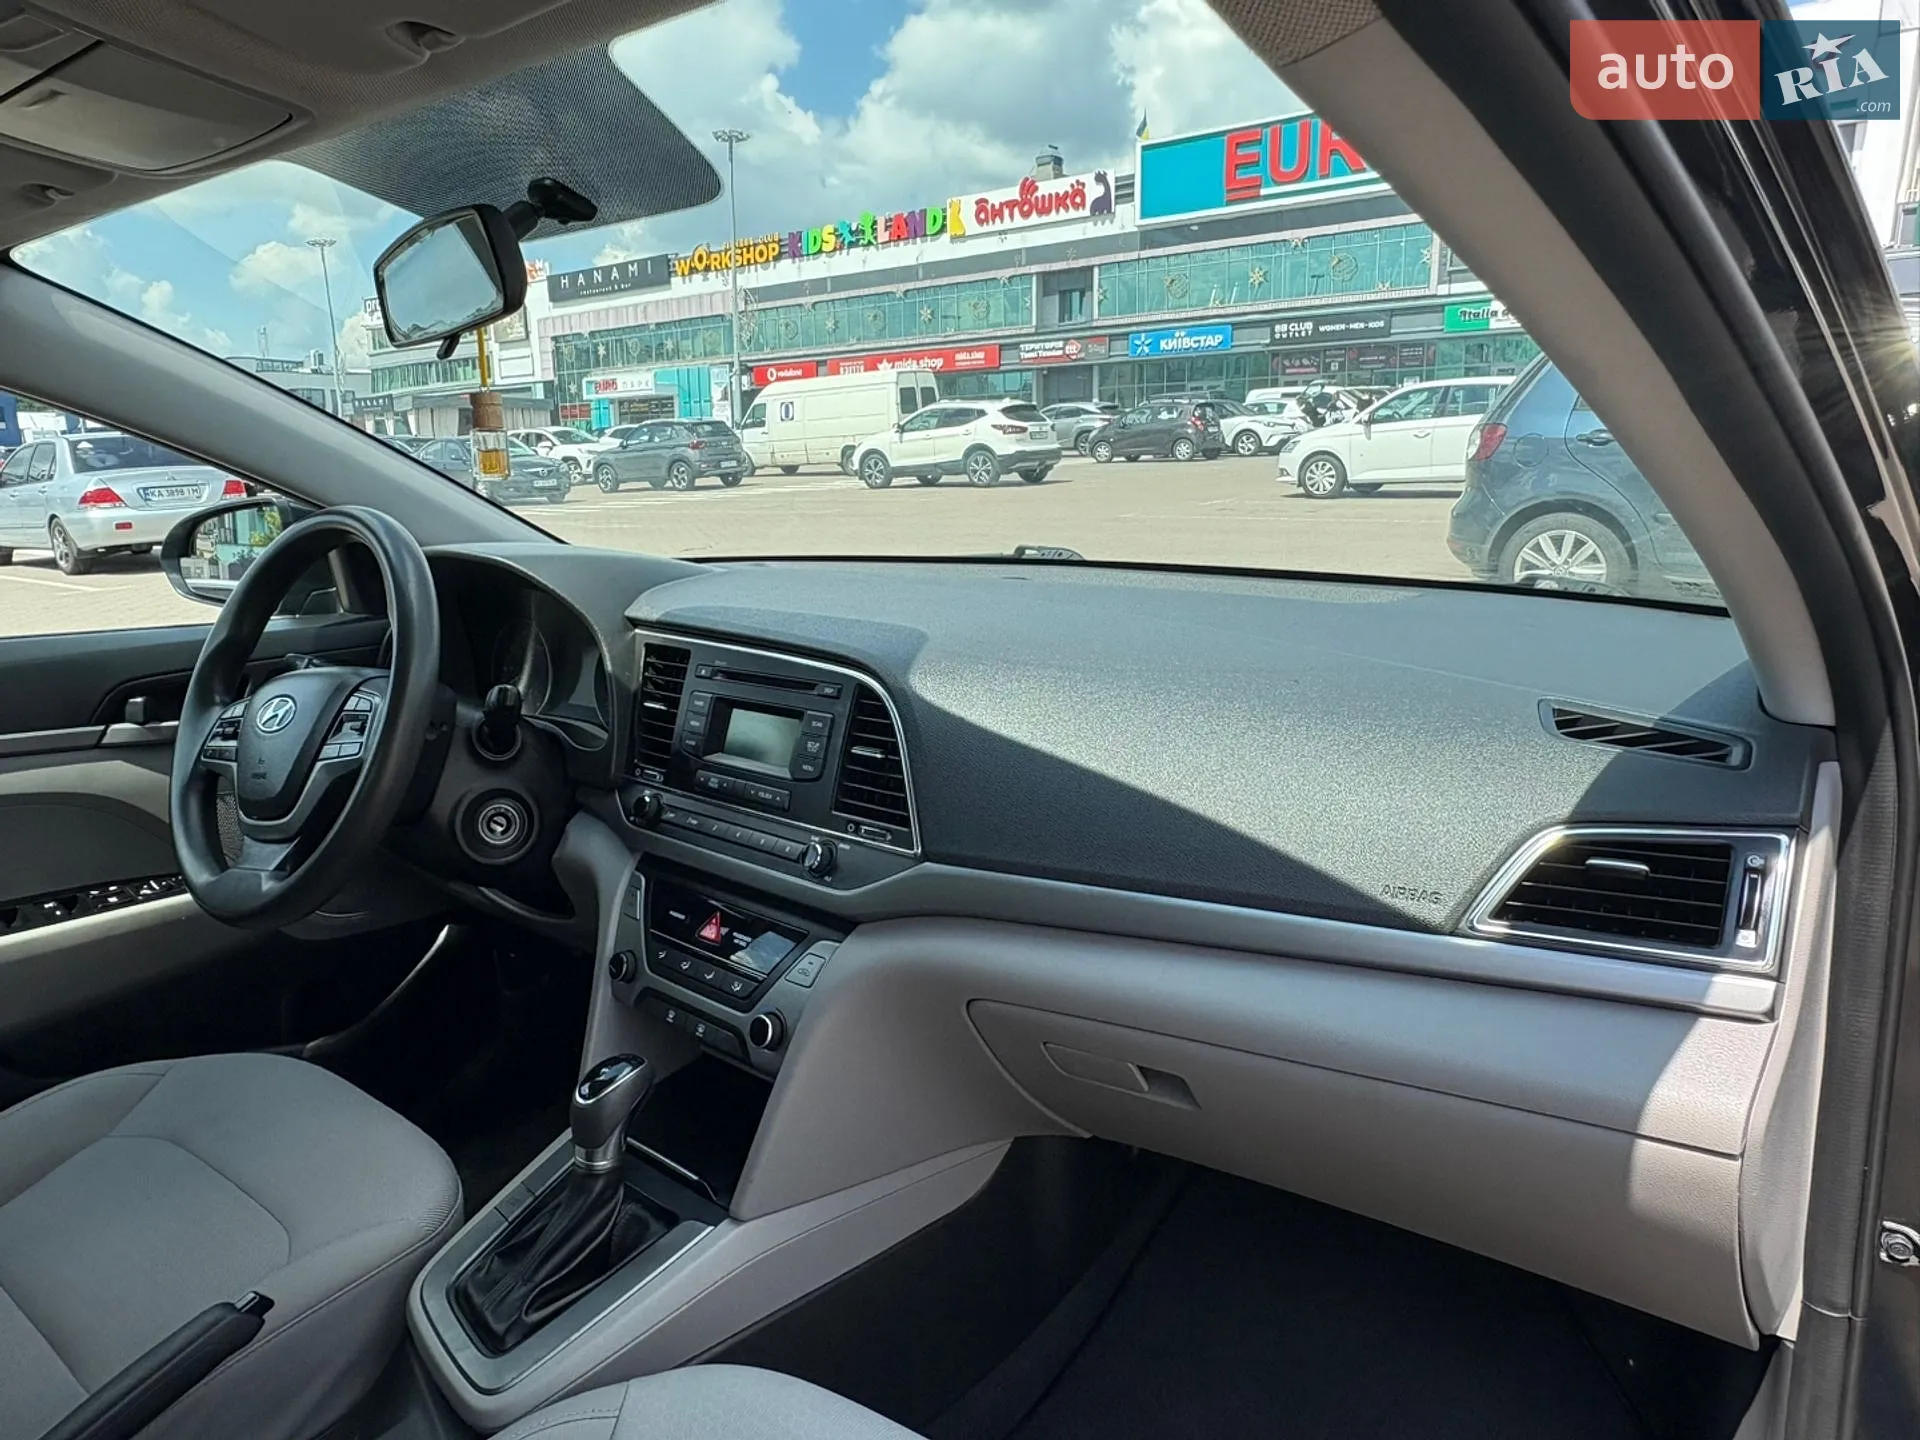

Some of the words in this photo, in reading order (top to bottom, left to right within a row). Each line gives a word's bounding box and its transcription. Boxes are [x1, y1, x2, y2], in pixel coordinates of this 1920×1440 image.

[787, 224, 836, 258] KIDS
[877, 207, 944, 243] LAND
[559, 259, 652, 290] HANAMI
[1159, 331, 1223, 351] КИЇВСТАР
[1380, 884, 1443, 905] AIRBAG
